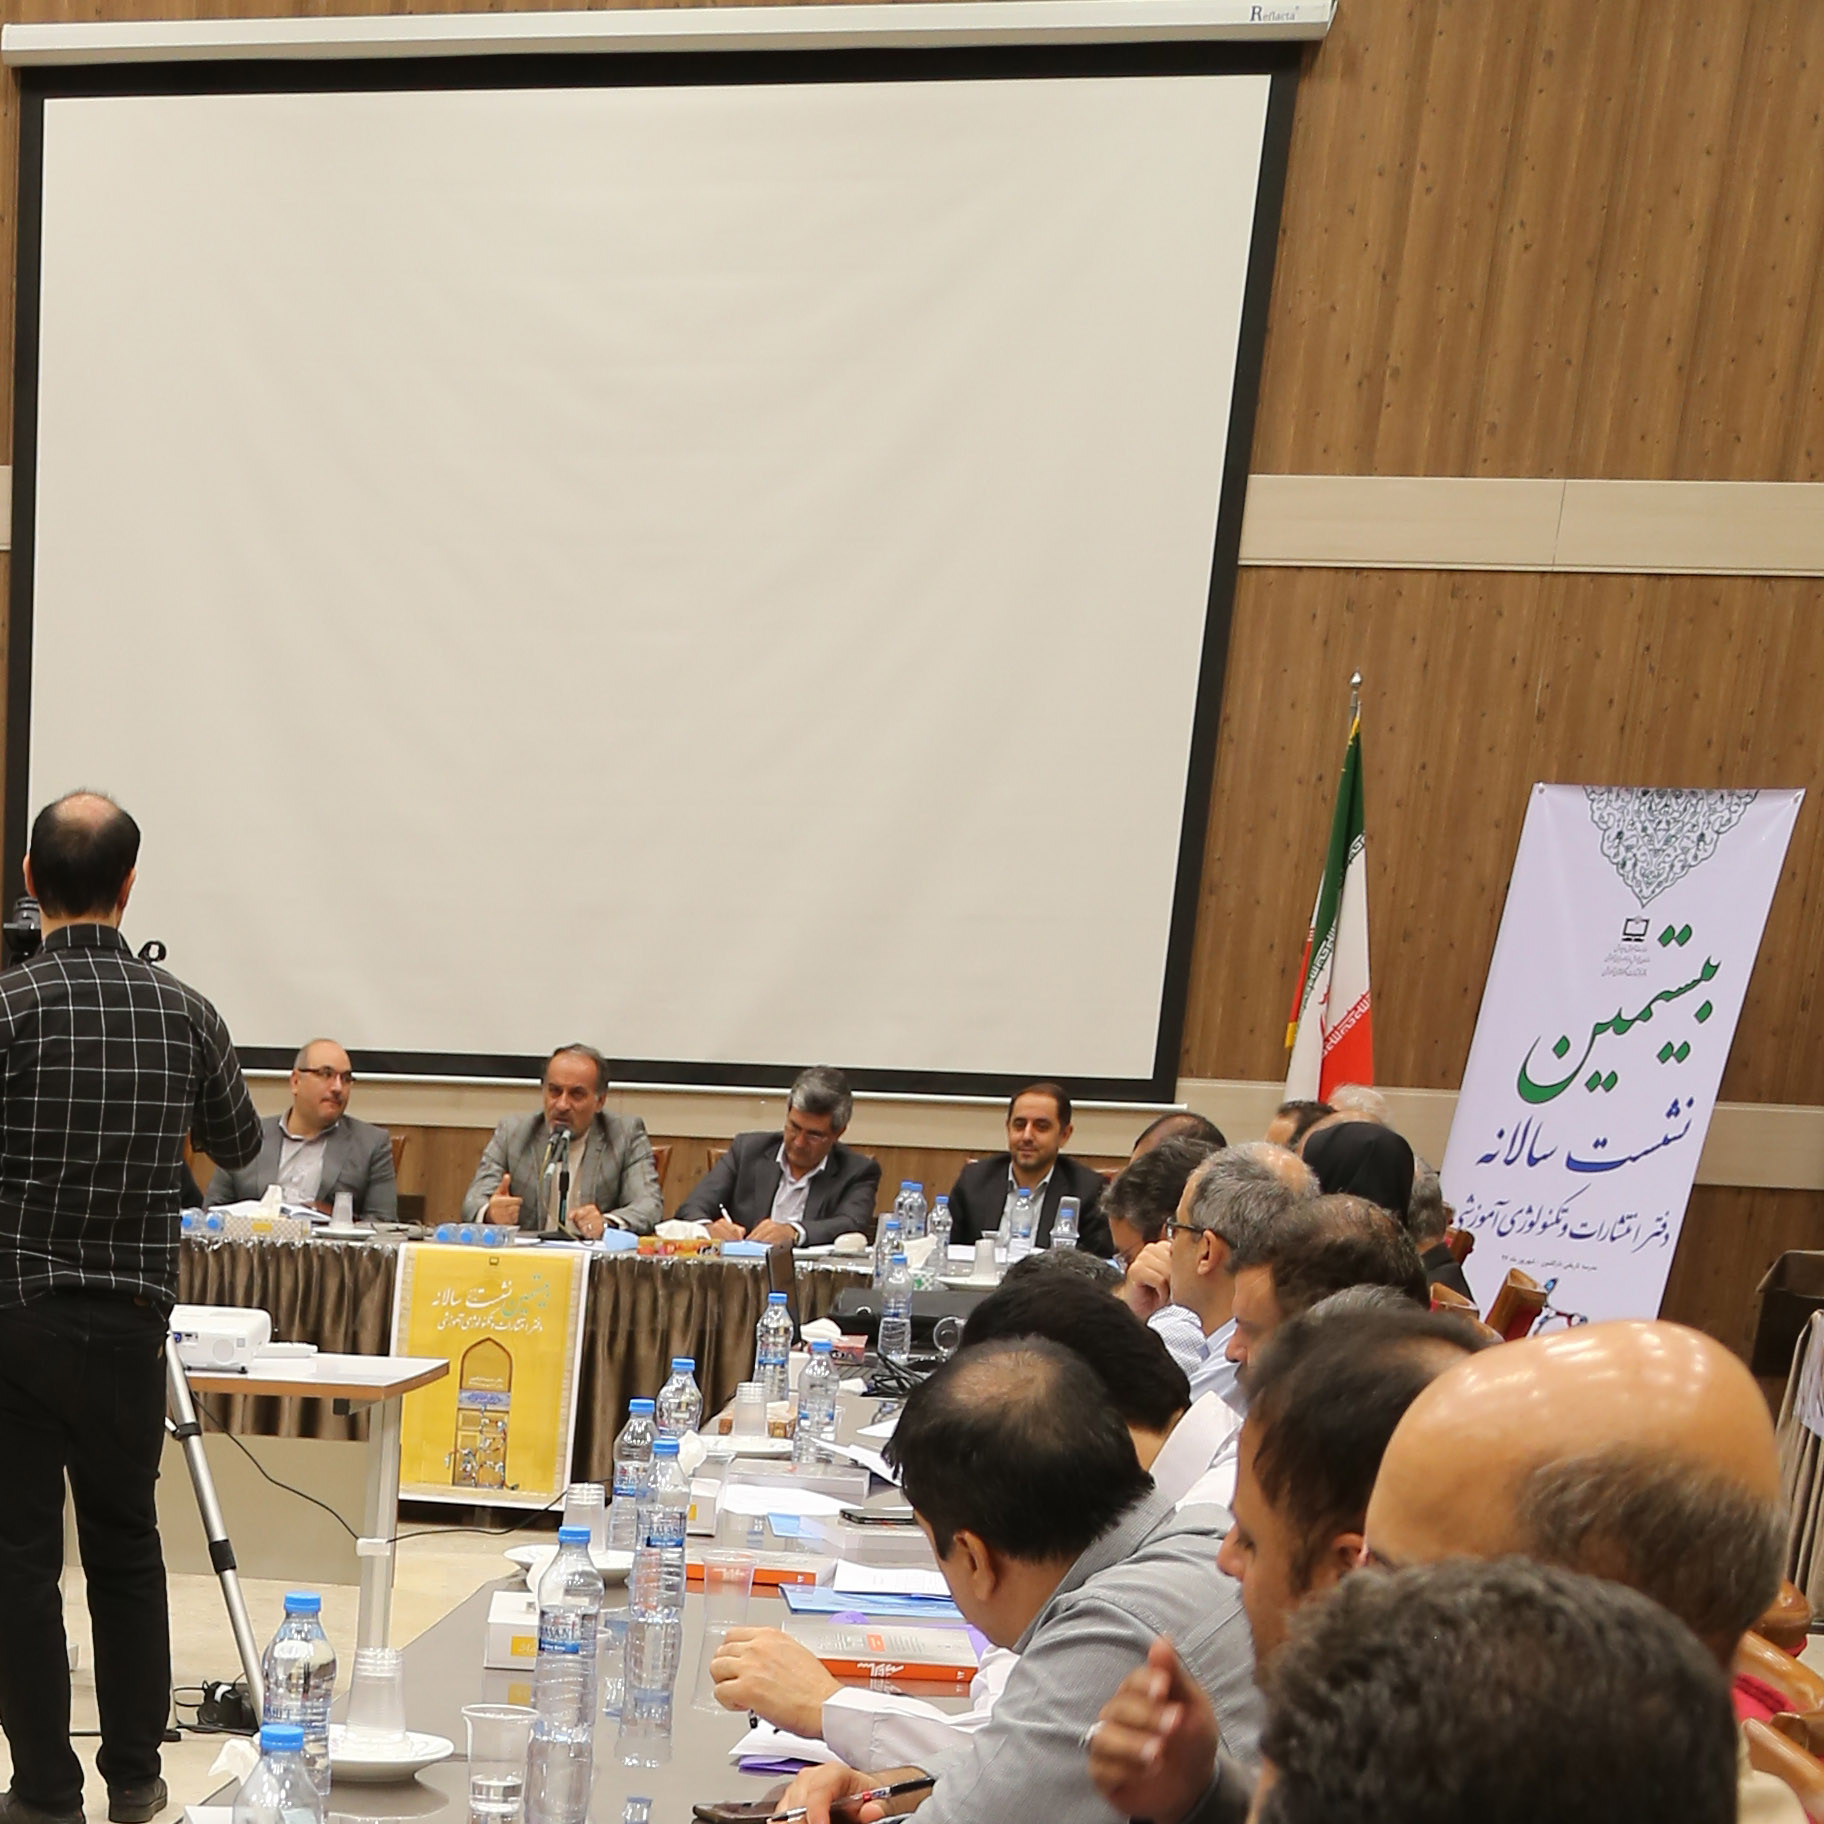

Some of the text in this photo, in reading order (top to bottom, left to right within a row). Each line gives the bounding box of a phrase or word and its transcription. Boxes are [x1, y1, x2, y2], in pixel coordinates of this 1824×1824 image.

[1517, 923, 1722, 1104] بیستمین
[1475, 1096, 1695, 1173] نشست سالانه
[1568, 1212, 1641, 1242] انتشارات
[1631, 1210, 1670, 1253] دفتر
[431, 1286, 463, 1307] سالانه
[465, 1279, 513, 1309] نشست
